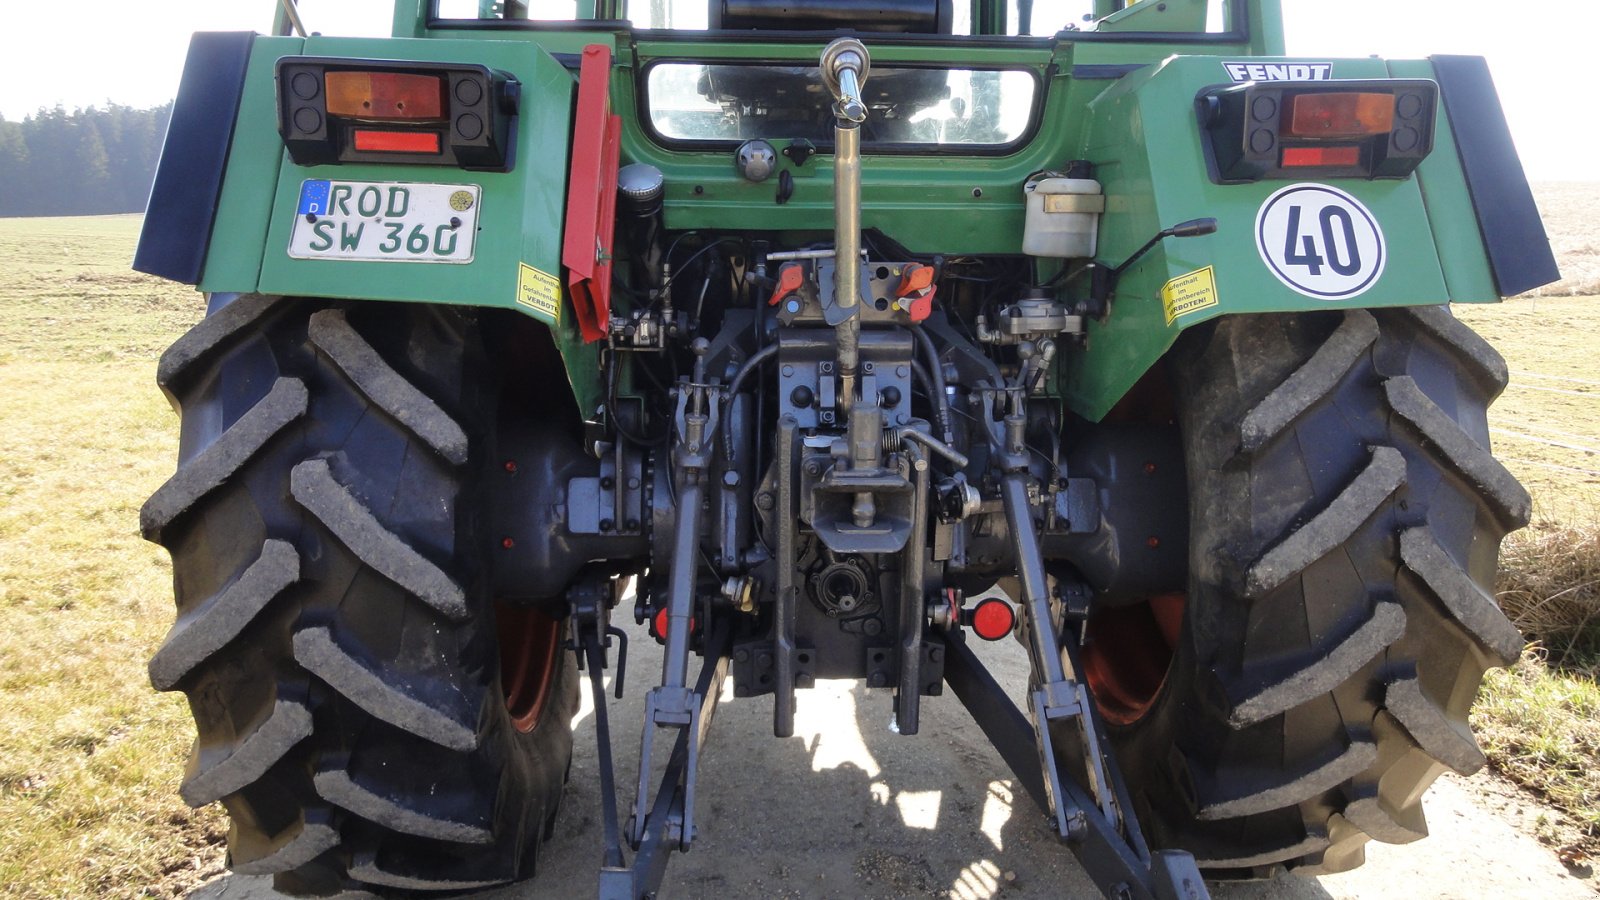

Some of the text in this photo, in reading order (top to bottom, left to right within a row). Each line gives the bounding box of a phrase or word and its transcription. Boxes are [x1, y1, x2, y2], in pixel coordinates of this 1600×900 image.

[1226, 64, 1329, 80] FENDT
[309, 202, 319, 213] D
[328, 185, 410, 217] ROD
[309, 221, 458, 256] SW 360
[1284, 205, 1361, 276] 40
